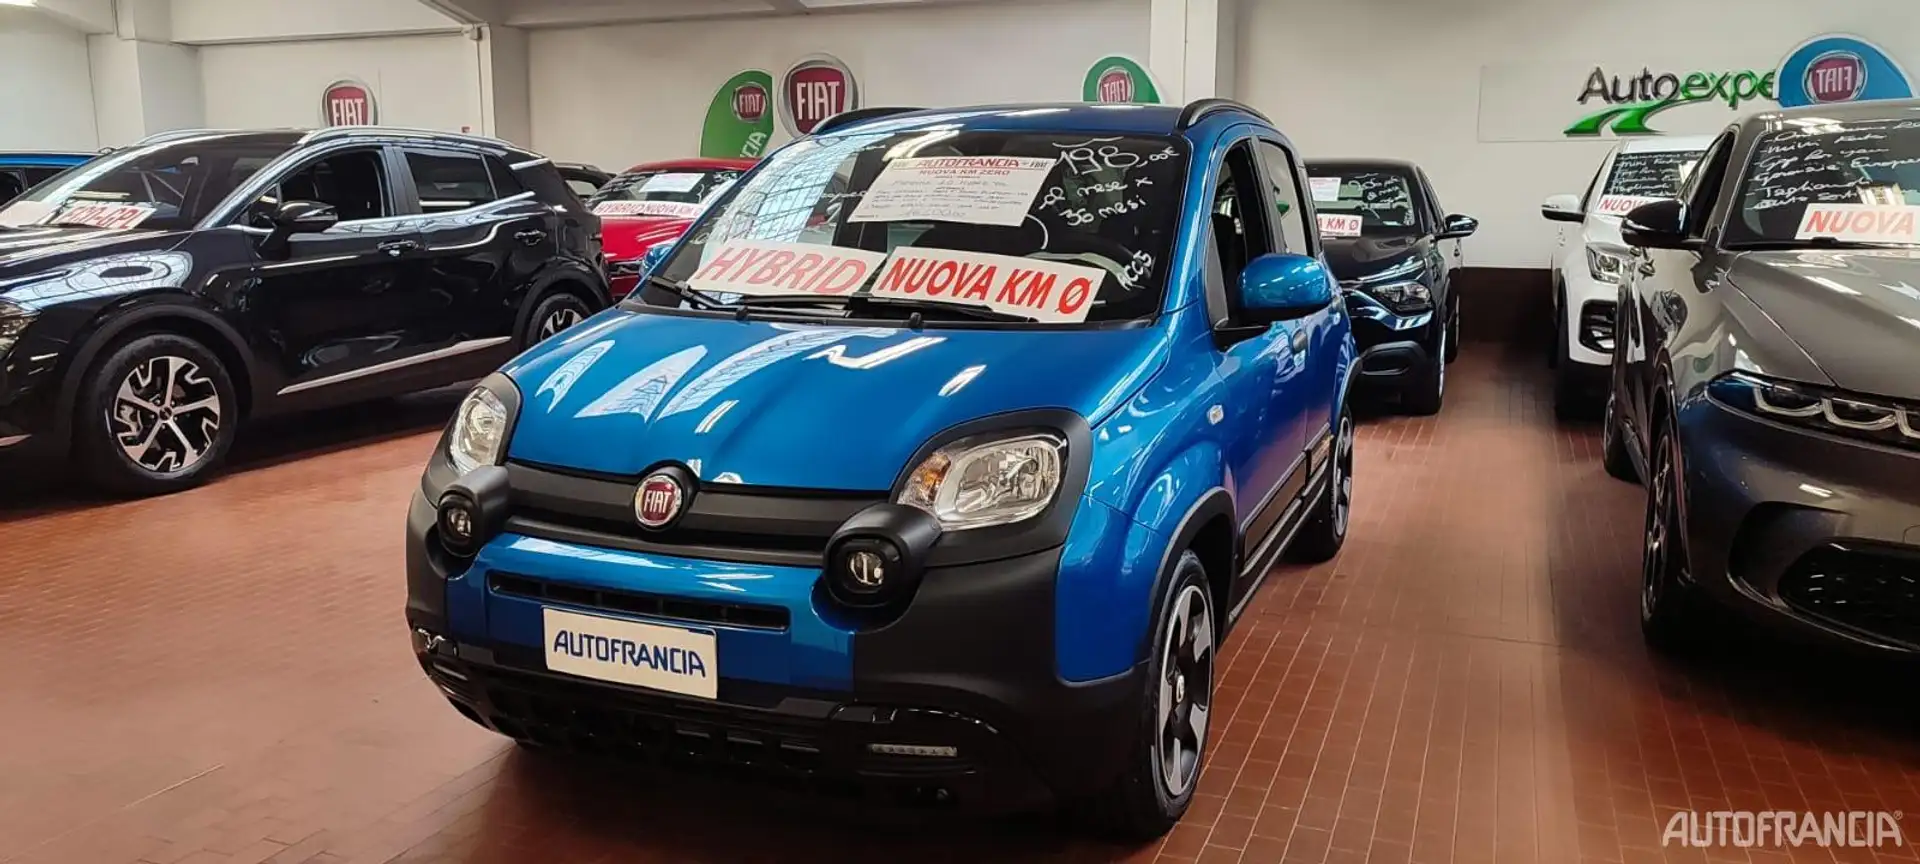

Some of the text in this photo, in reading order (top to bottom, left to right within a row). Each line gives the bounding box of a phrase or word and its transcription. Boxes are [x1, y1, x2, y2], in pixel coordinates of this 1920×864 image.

[331, 98, 364, 126] FIAT
[739, 93, 762, 113] FIAT
[796, 81, 840, 120] FIAT
[980, 169, 1010, 177] ZERO
[1077, 180, 1128, 198] mese
[1058, 194, 1147, 227] 36 mesi
[1600, 199, 1648, 211] NUOV
[1327, 217, 1345, 229] KM
[1804, 210, 1915, 235] NUOVA
[696, 246, 867, 293] HYBRID
[878, 257, 997, 301] NUOVA
[1000, 267, 1058, 310] KM
[643, 489, 672, 514] FIAT
[553, 629, 706, 678] AUTOFRANCIA
